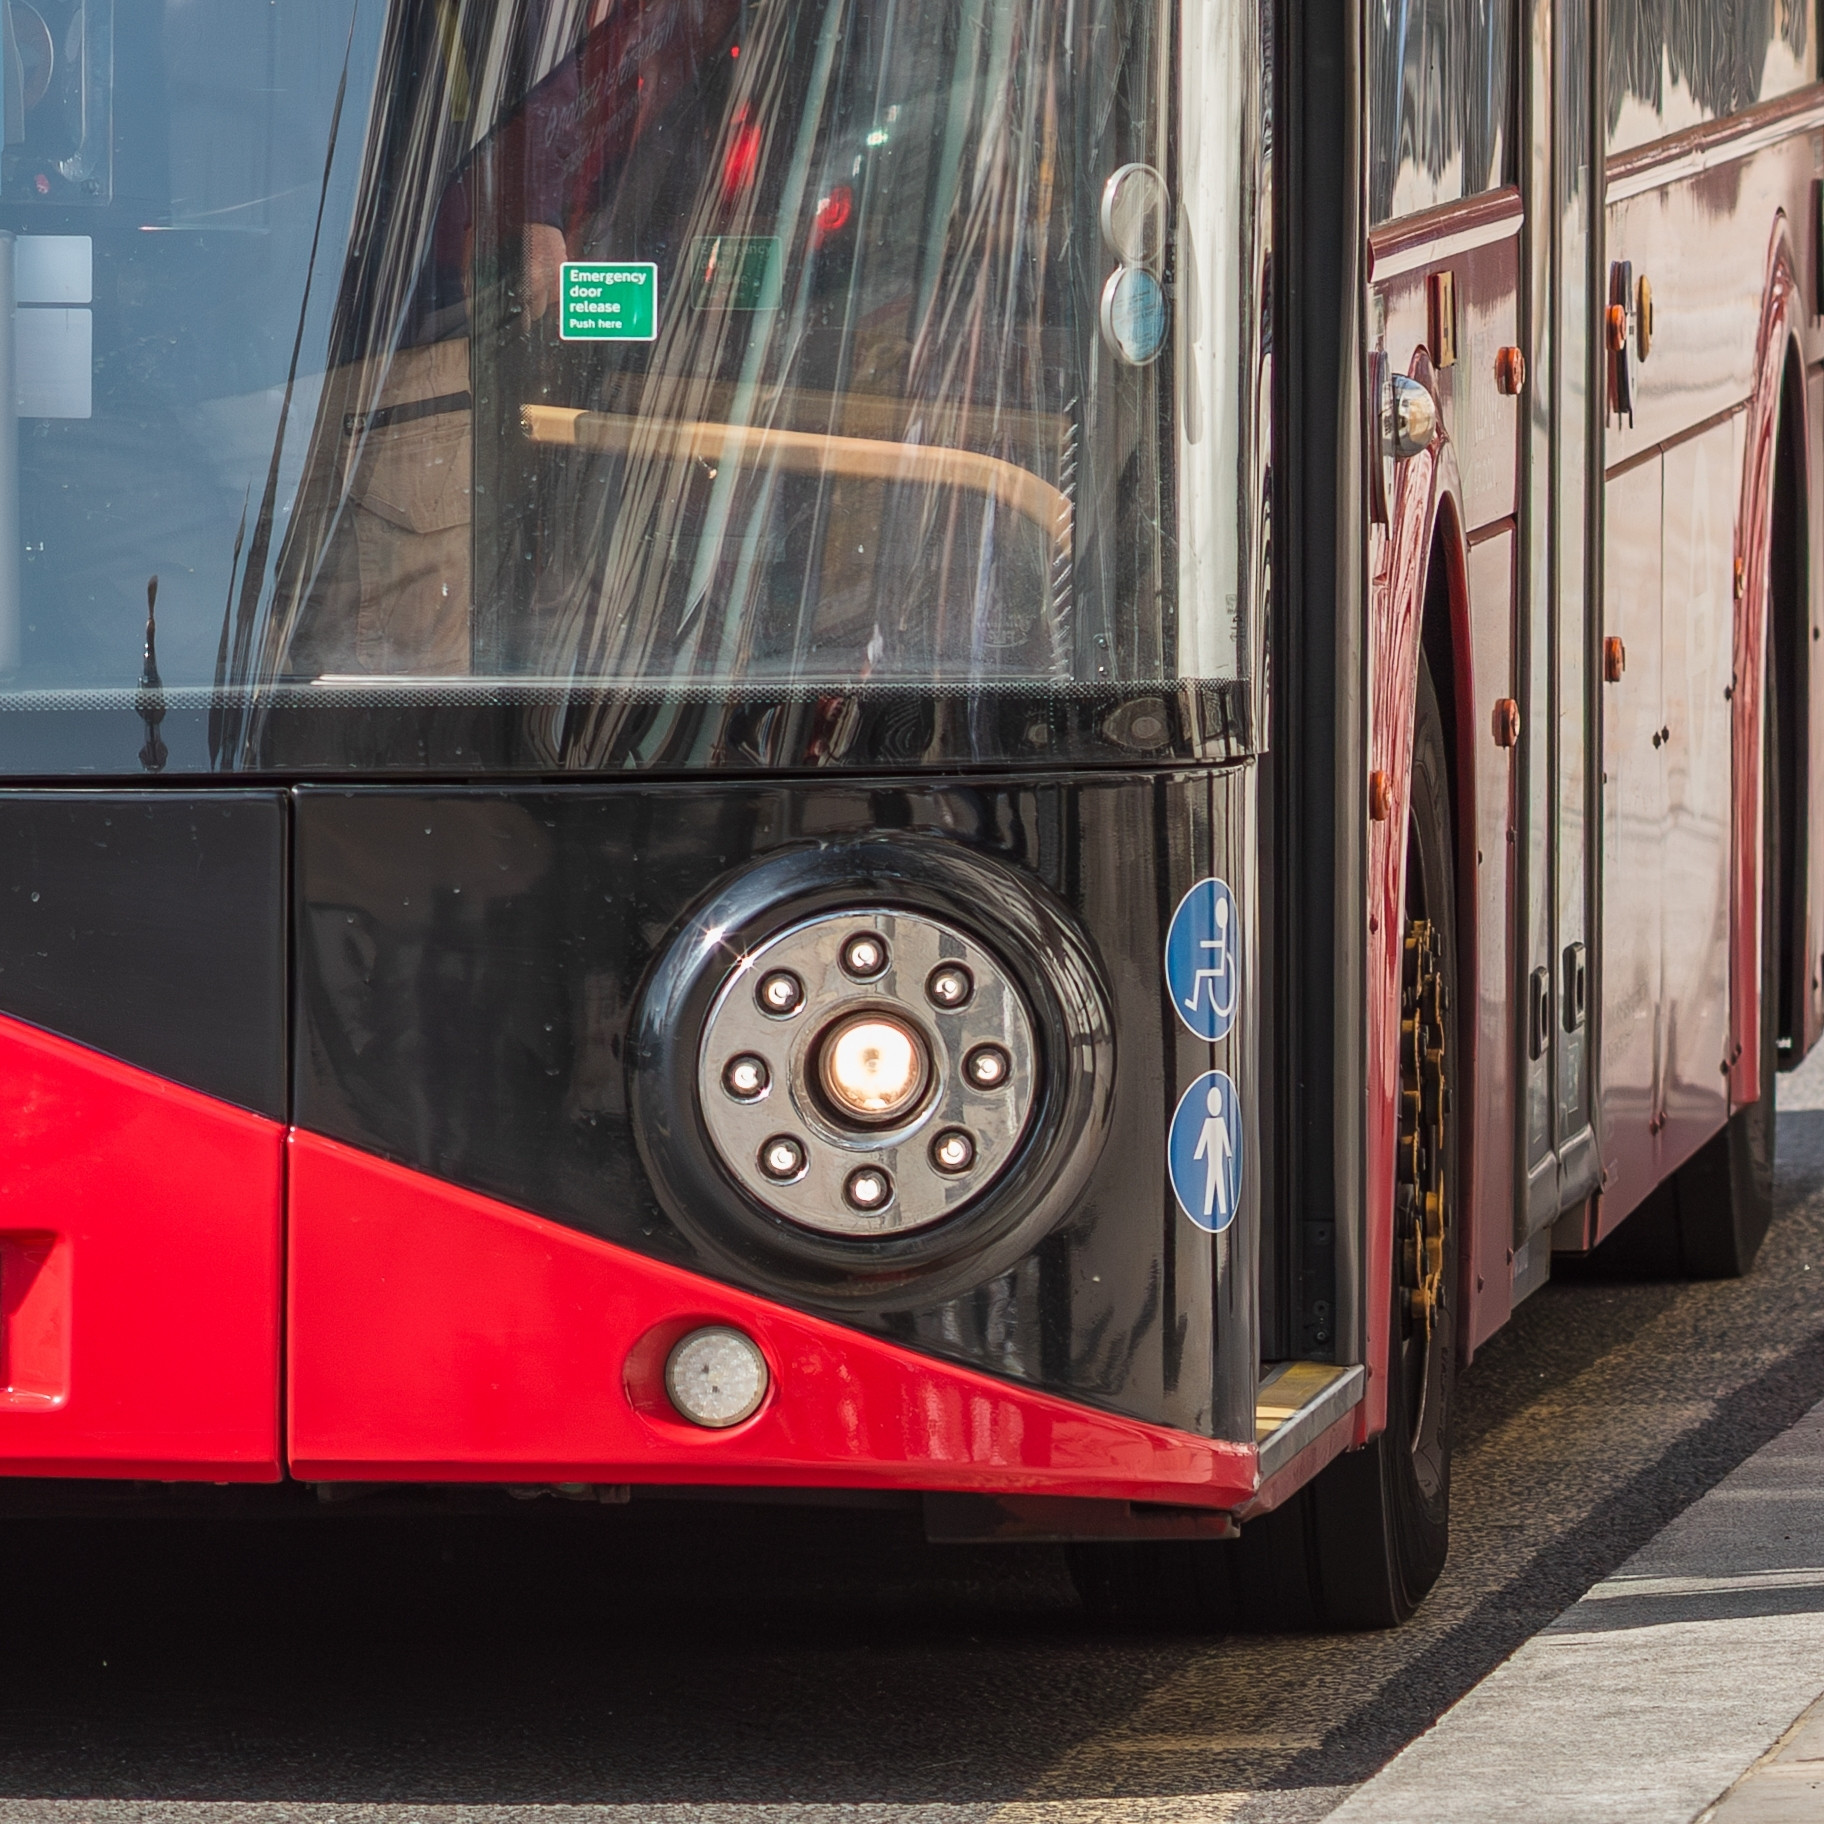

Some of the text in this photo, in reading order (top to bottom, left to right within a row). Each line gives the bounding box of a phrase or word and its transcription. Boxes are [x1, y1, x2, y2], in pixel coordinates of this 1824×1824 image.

[570, 269, 646, 284] Emergency
[569, 285, 602, 298] door
[569, 301, 621, 313] release
[569, 318, 622, 329] Push here
